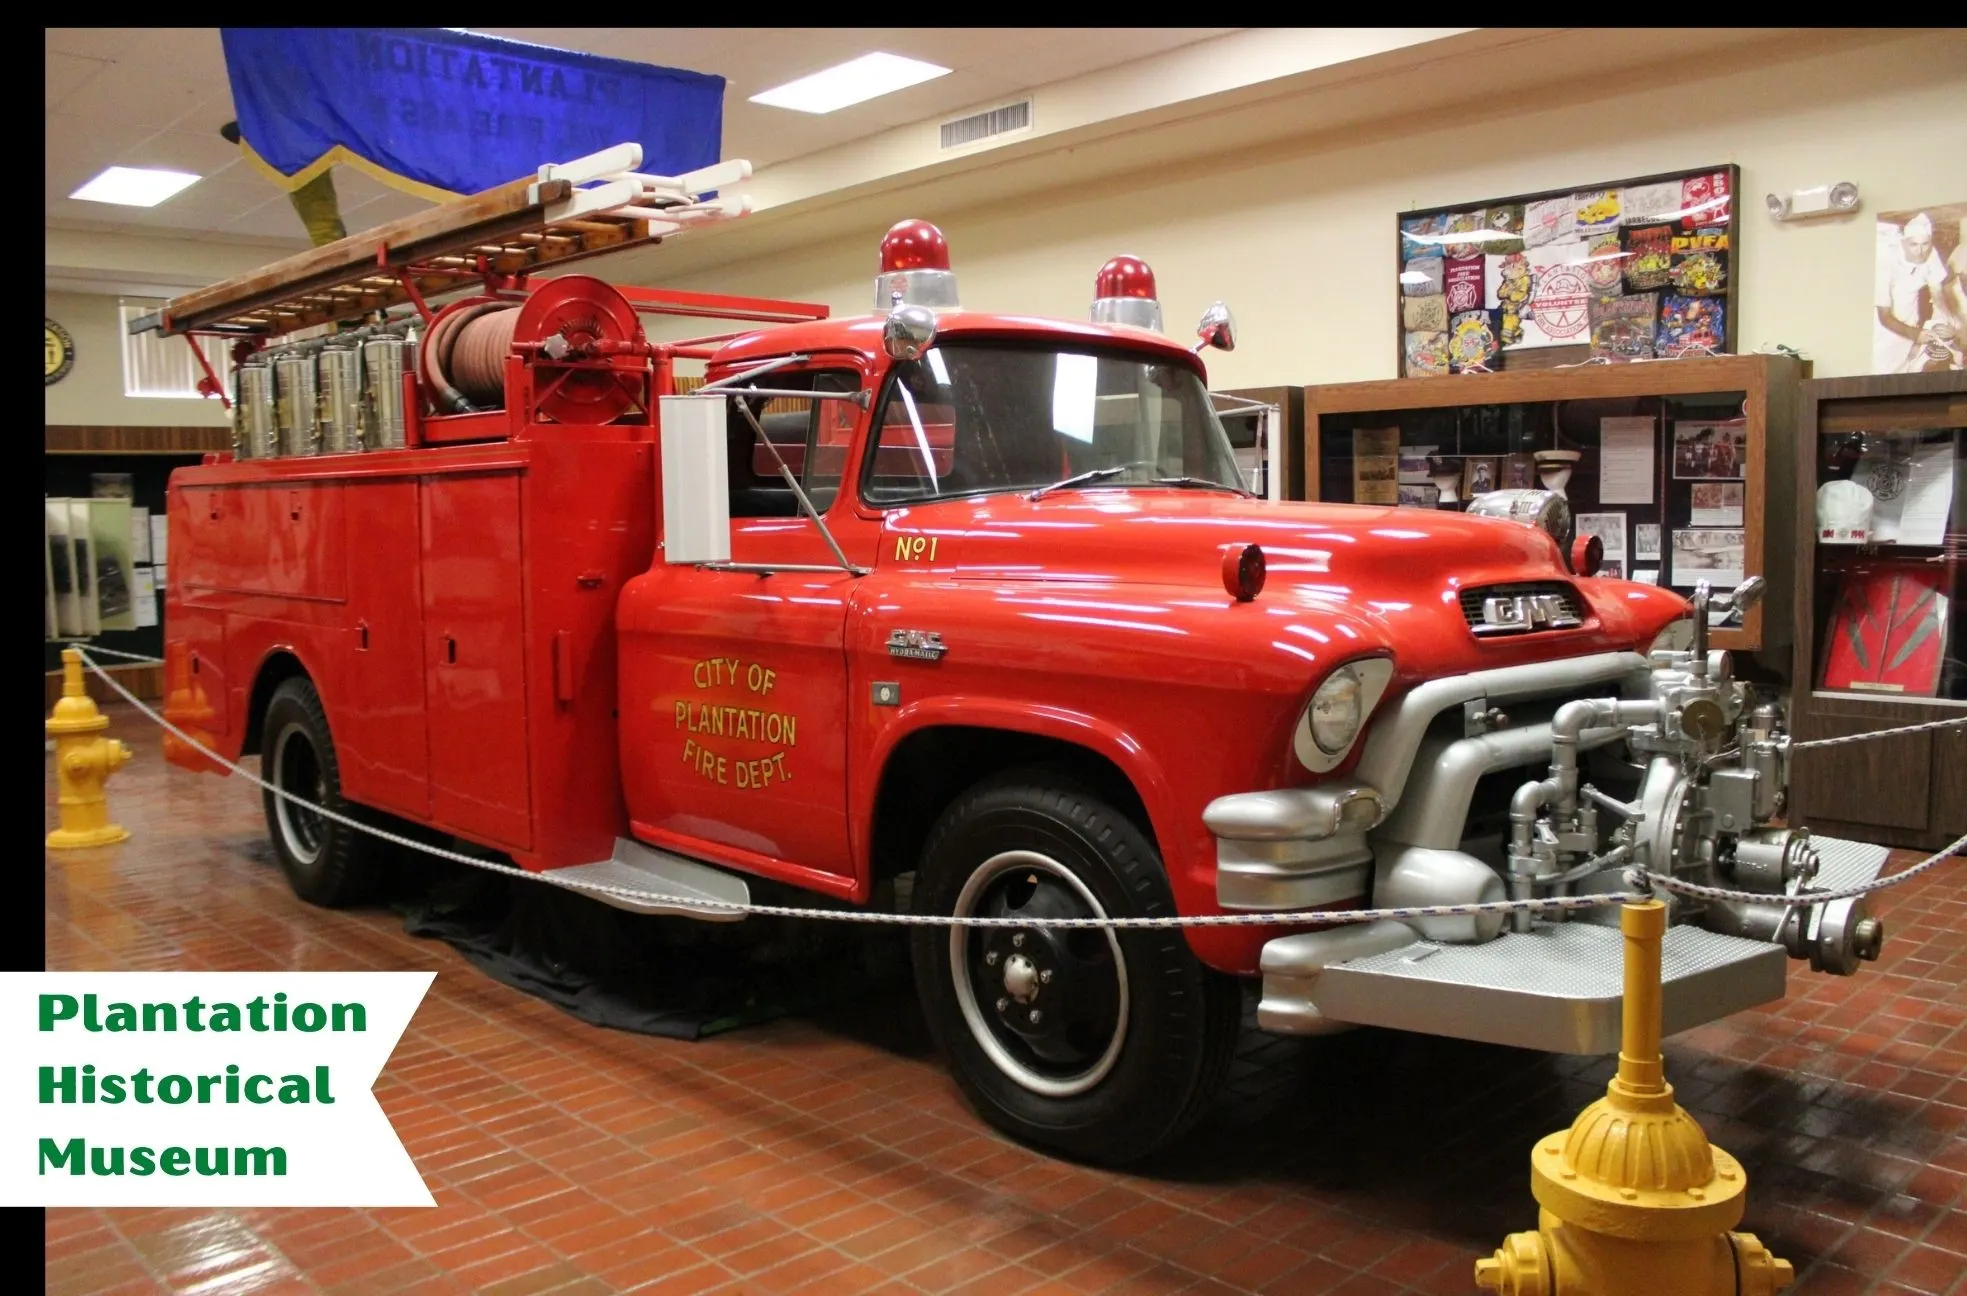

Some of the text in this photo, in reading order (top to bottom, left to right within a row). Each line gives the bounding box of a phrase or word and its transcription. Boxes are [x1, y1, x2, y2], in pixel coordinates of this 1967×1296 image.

[1472, 594, 1582, 630] GMC
[694, 658, 776, 696] CITY OF
[675, 702, 796, 746] PLANTATION
[682, 739, 792, 789] FIRE DEPT.
